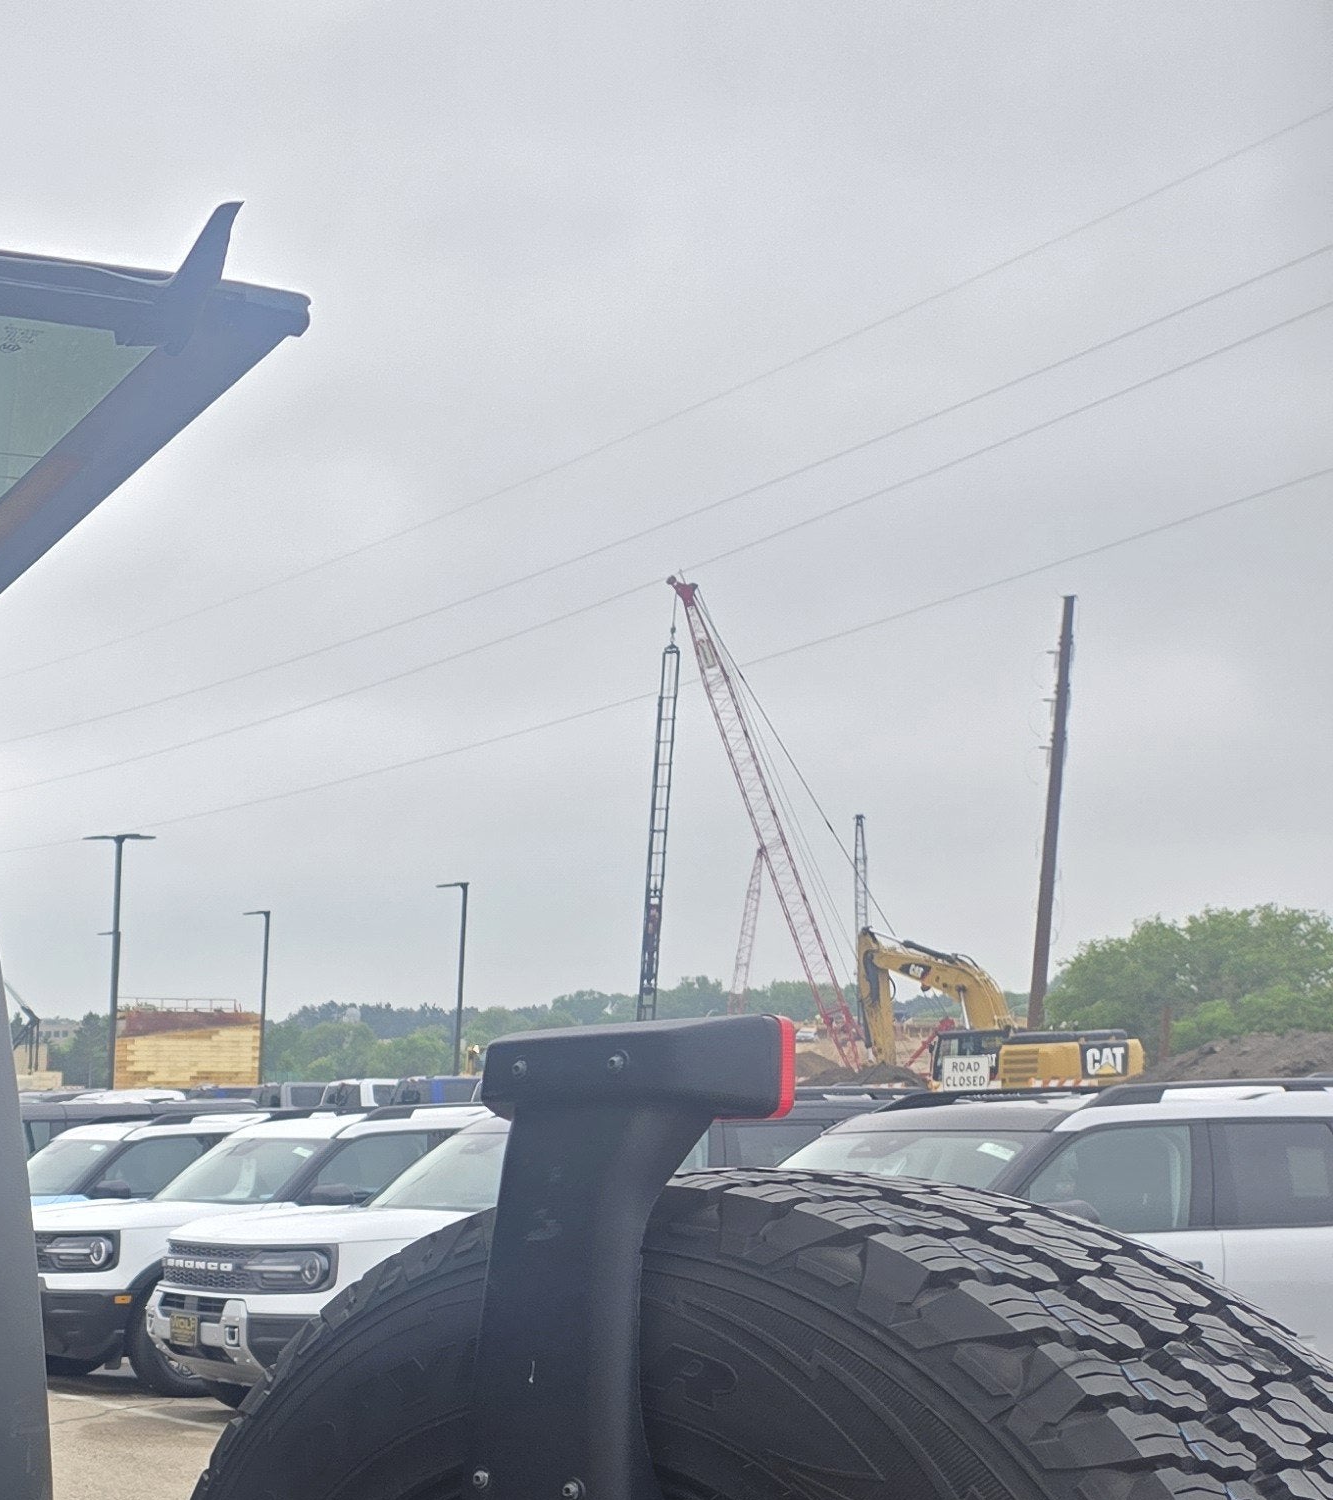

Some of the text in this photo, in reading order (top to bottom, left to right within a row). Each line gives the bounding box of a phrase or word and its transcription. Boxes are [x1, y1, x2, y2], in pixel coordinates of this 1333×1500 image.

[952, 1061, 980, 1073] ROAD
[1086, 1047, 1124, 1076] CAT
[945, 1076, 986, 1088] CLOSED
[166, 1258, 233, 1272] BRONCO
